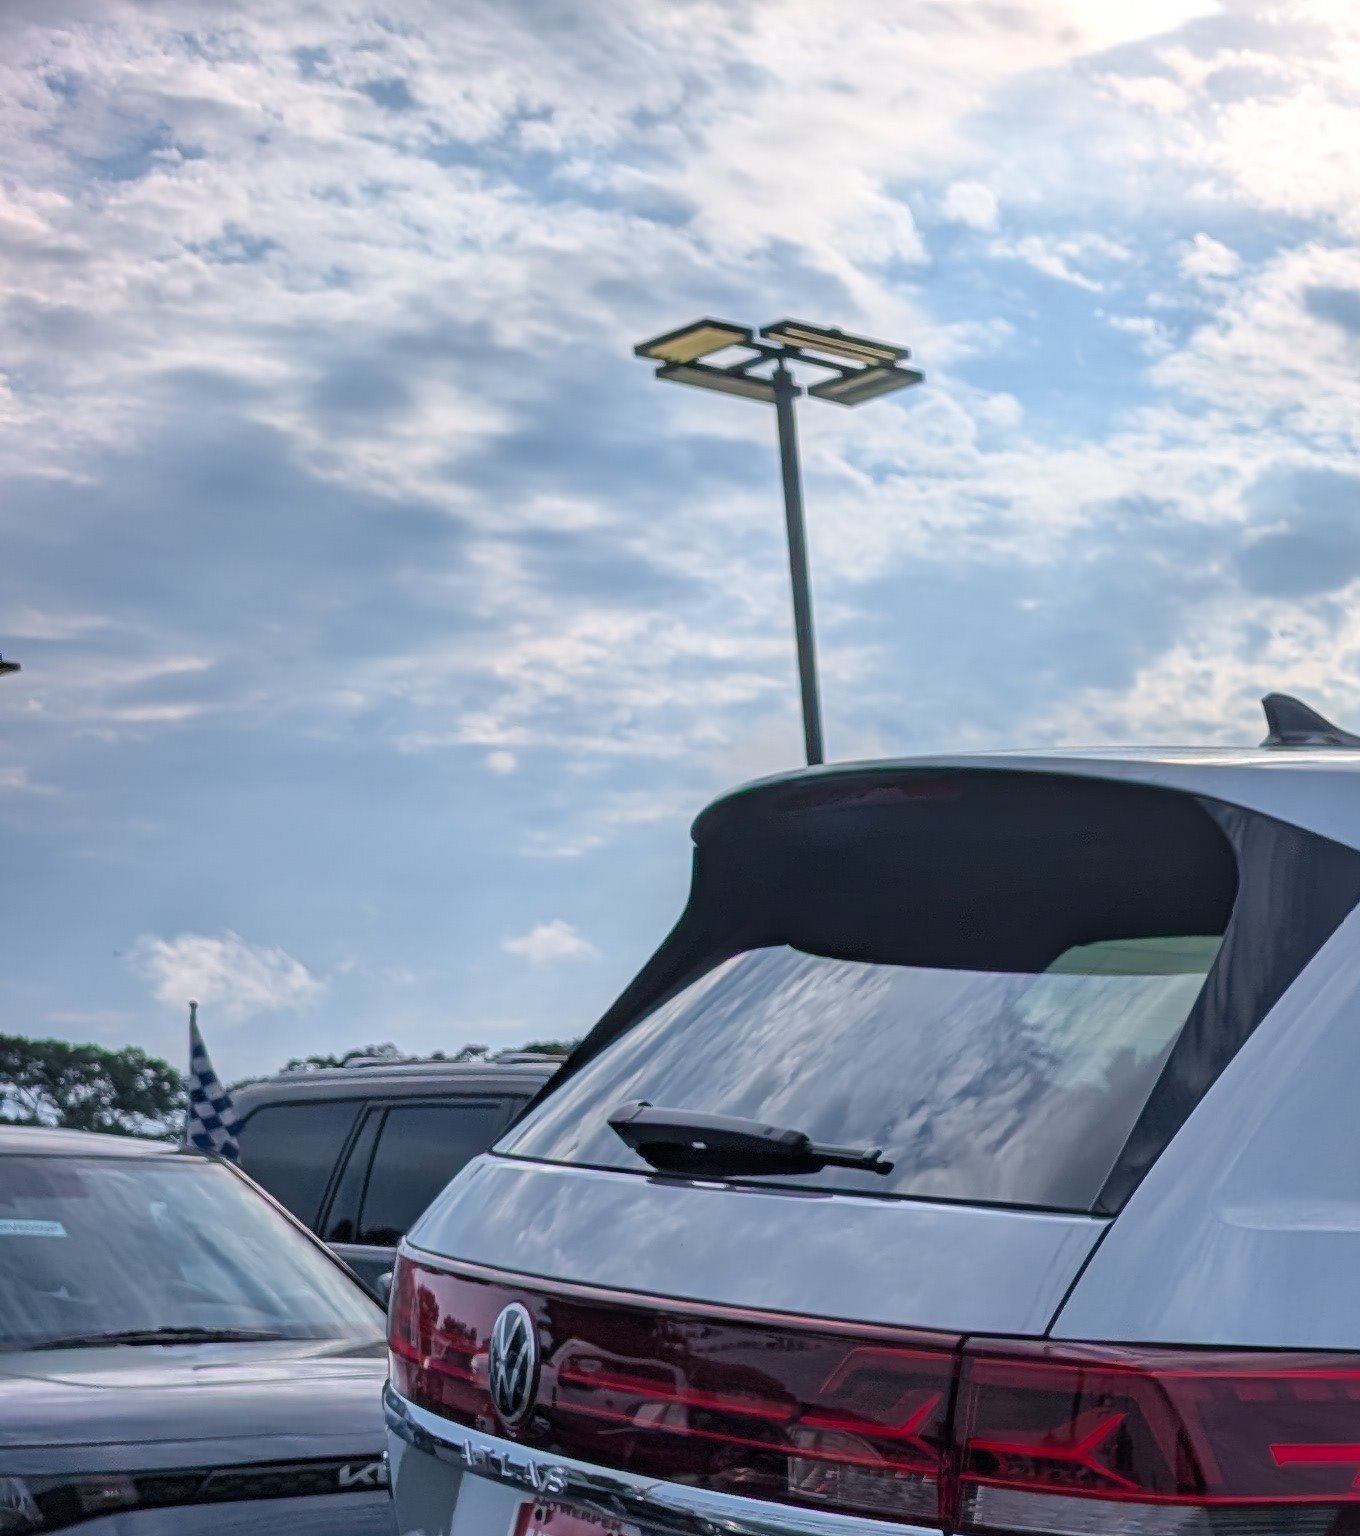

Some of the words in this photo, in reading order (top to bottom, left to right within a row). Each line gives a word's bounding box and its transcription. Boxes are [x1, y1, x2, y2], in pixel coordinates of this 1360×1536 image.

[490, 1303, 535, 1423] VW
[338, 1462, 389, 1487] KI
[461, 1438, 568, 1494] ATLAS
